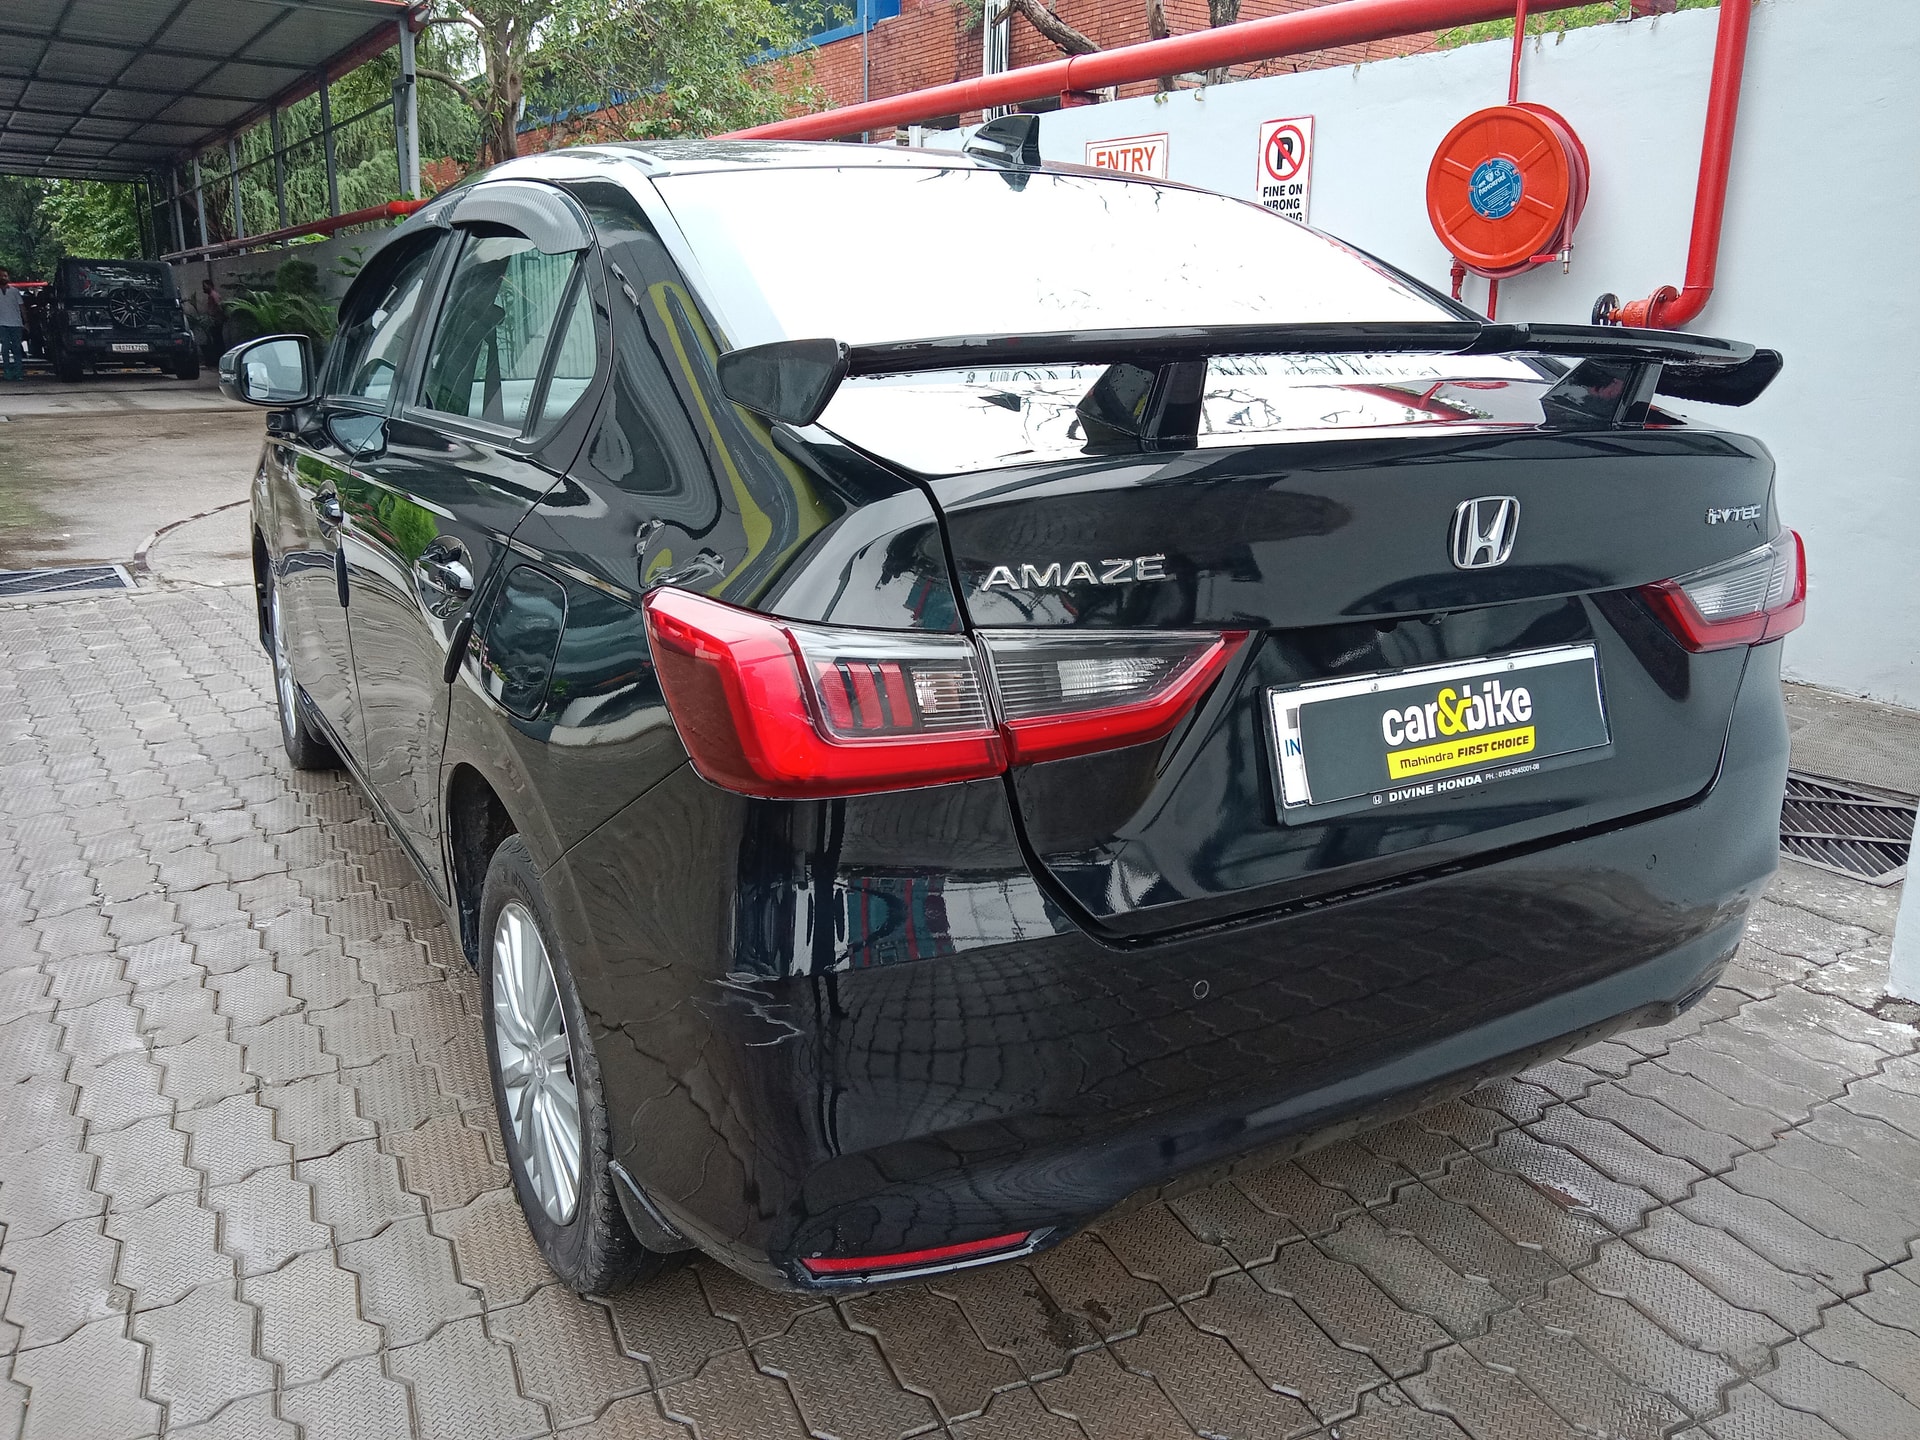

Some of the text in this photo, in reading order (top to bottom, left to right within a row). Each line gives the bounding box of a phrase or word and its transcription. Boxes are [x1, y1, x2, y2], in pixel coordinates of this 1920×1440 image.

[1096, 146, 1156, 172] ENTRY
[1263, 183, 1303, 197] FINE ON
[981, 553, 1167, 592] AMAZE
[1382, 680, 1533, 746] car&bike
[1400, 735, 1529, 769] Mahindra FIRST CHOICE
[1388, 784, 1434, 802] DIVINE
[1437, 774, 1483, 793] HONDA
